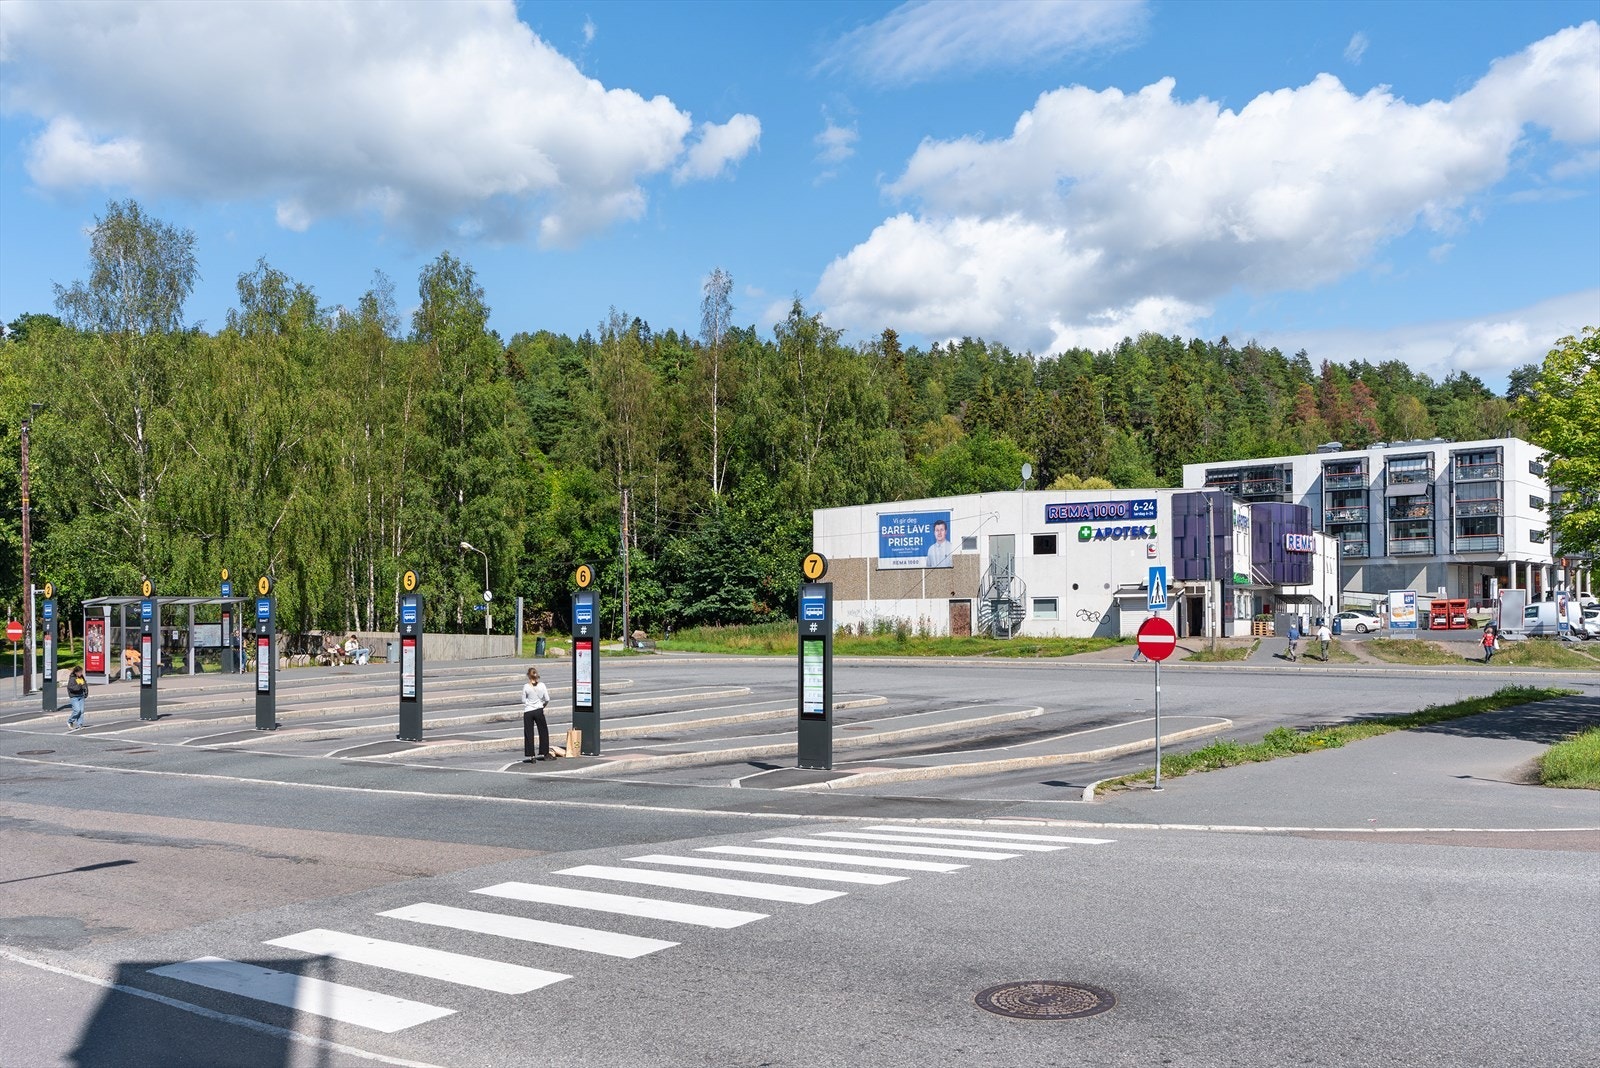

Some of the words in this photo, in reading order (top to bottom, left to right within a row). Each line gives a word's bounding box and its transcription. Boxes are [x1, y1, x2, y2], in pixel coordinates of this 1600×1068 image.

[1048, 506, 1090, 519] REMA
[1094, 504, 1126, 516] 1000
[1133, 502, 1154, 511] 6-24
[881, 526, 905, 535] BARE
[907, 524, 931, 534] LAVE
[1095, 526, 1148, 540] APOTEK
[888, 537, 923, 547] PRISER!
[809, 559, 818, 574] 7
[406, 575, 412, 587] 5
[580, 570, 586, 583] 6
[46, 586, 50, 595] 2
[145, 583, 149, 593] 3
[261, 580, 266, 590] 4
